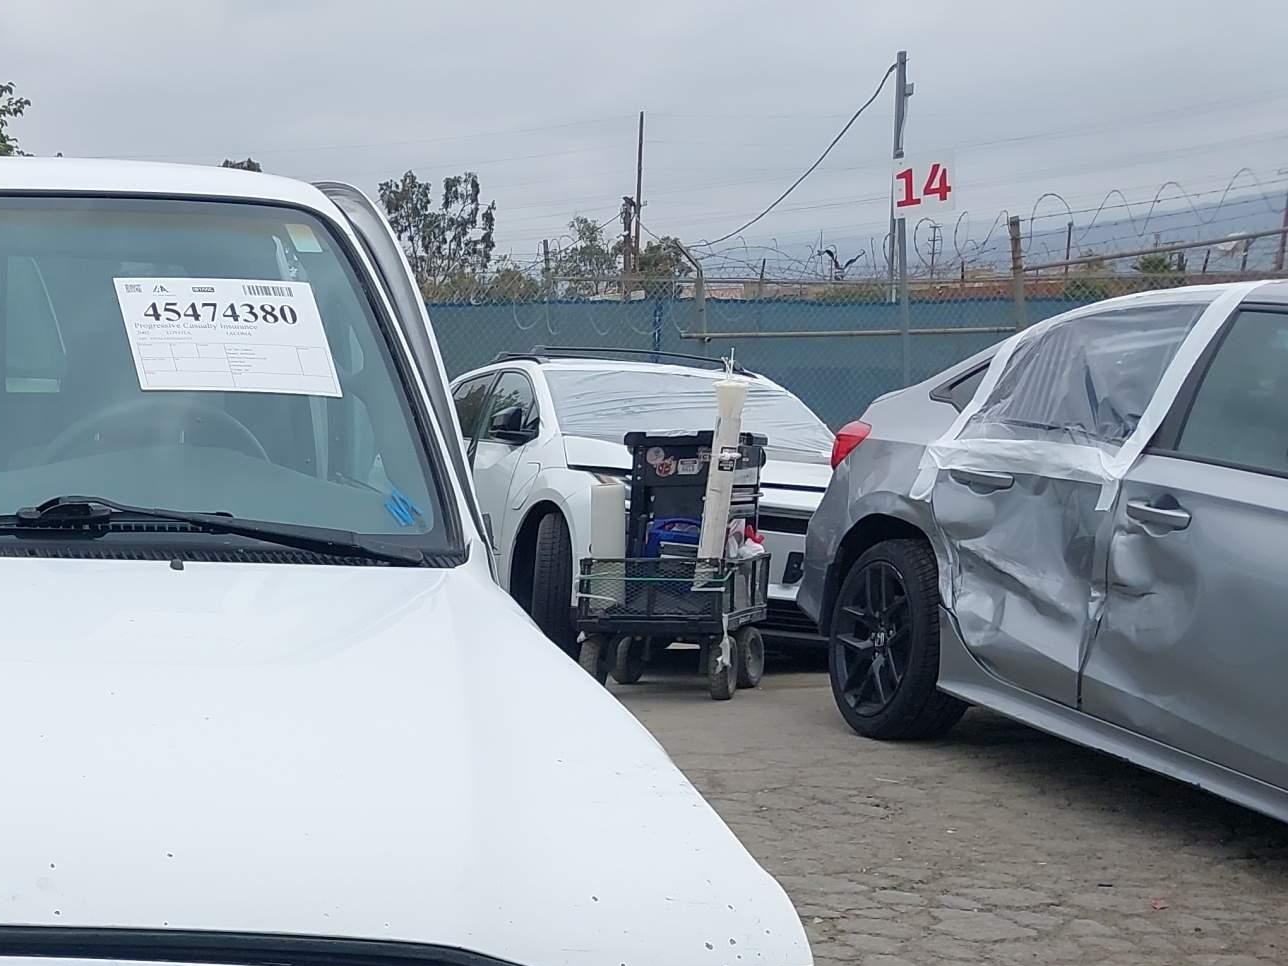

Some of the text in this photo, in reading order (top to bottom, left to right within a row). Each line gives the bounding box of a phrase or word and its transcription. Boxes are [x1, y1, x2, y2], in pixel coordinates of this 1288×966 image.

[896, 163, 951, 207] 14
[143, 302, 297, 324] 45474380
[134, 322, 181, 330] Progressive
[183, 322, 217, 330] Casualty
